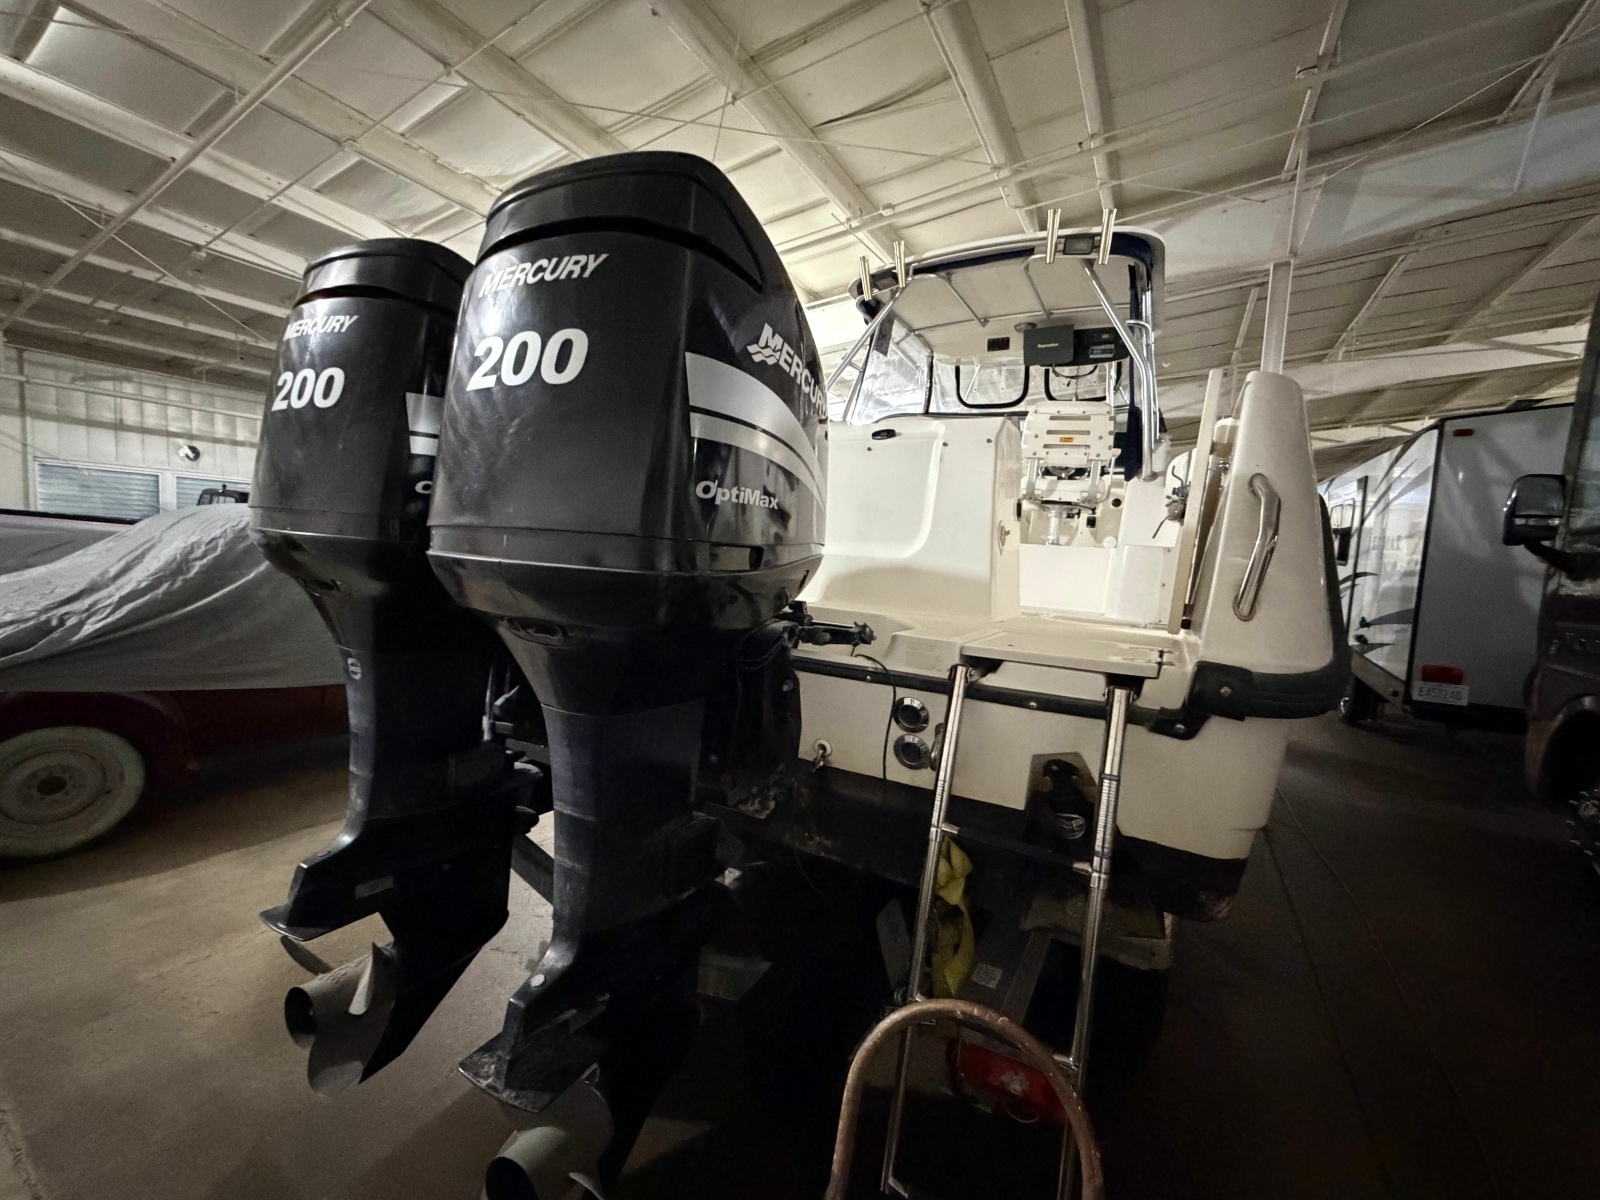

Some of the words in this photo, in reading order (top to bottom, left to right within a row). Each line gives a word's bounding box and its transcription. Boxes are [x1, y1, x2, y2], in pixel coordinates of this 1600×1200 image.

[478, 253, 609, 298] MERCURY
[282, 315, 359, 341] MERCURY
[466, 328, 589, 391] 200
[271, 367, 345, 412] 200
[695, 479, 779, 510] OptiMax
